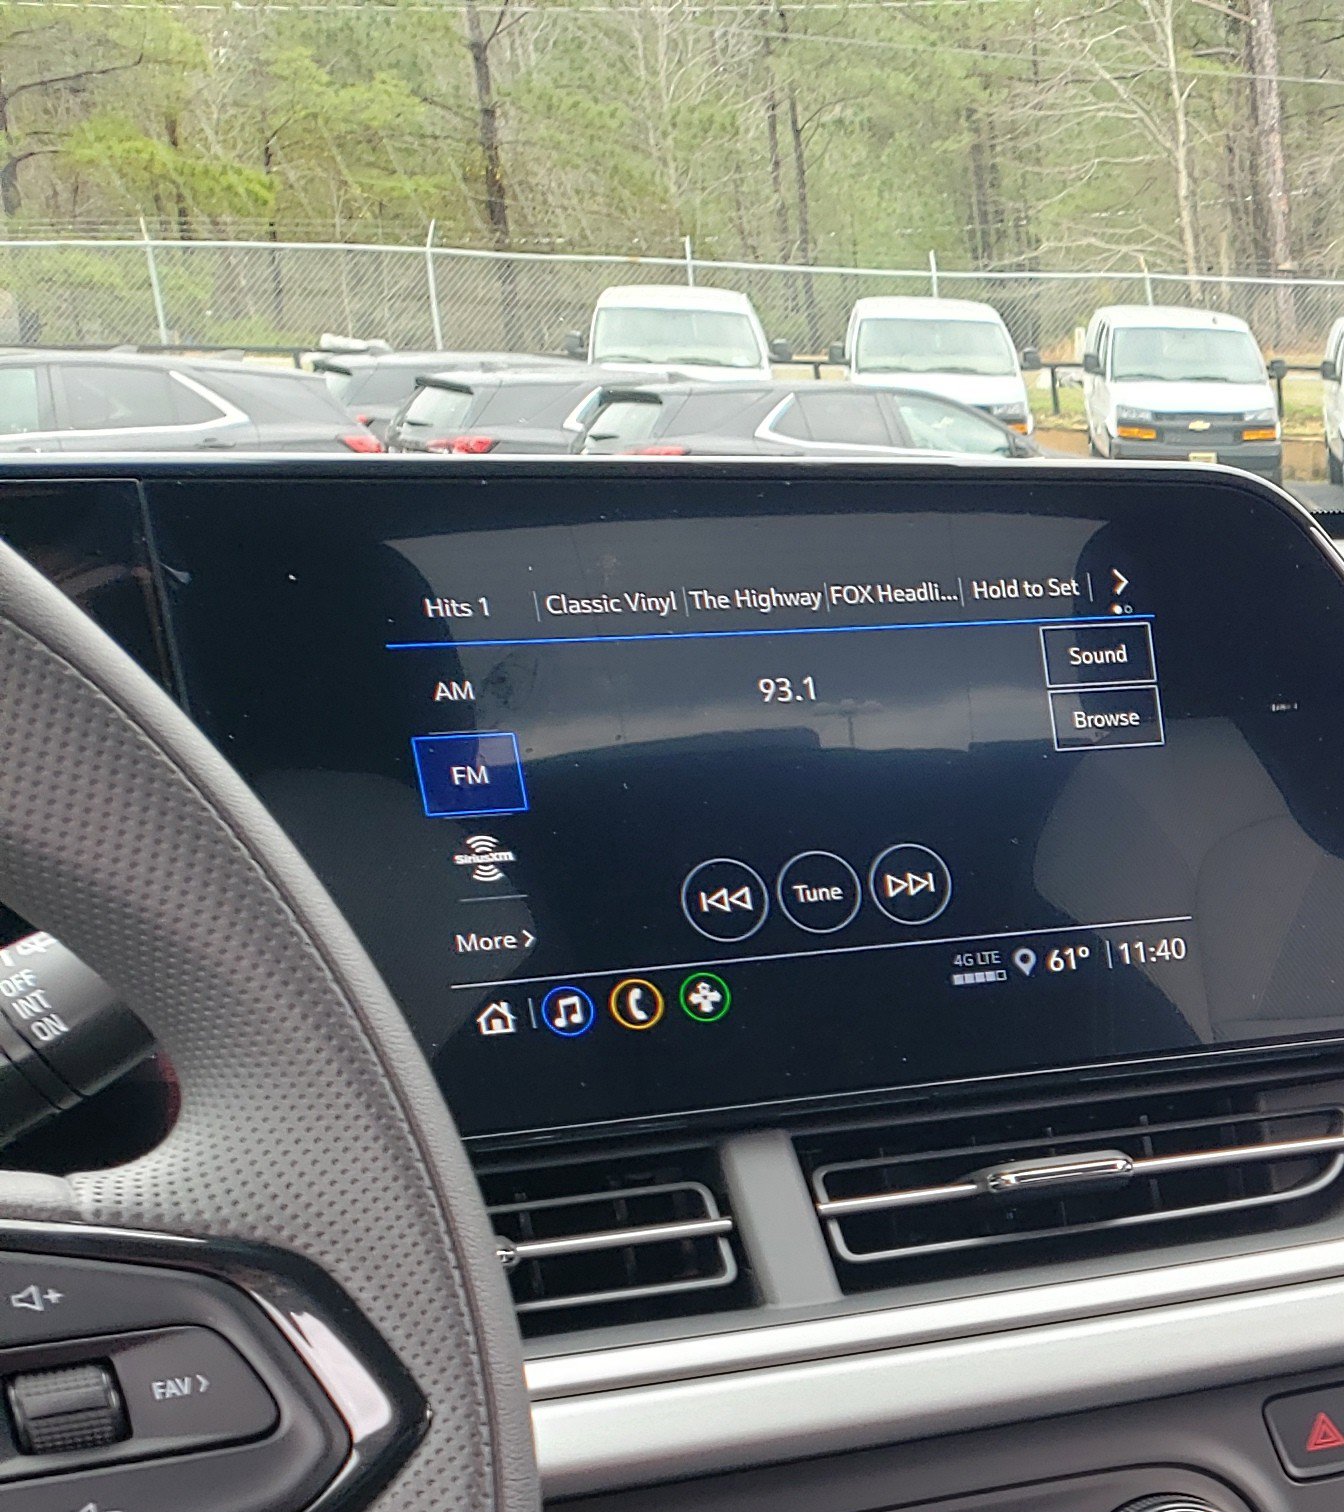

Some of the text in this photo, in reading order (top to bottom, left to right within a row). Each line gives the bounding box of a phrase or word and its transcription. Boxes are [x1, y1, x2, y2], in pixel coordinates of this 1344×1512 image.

[688, 586, 823, 614] The Highway
[829, 585, 874, 605] FOX
[972, 578, 1080, 600] Hold to Set
[424, 597, 490, 618] Hits 1
[545, 590, 678, 616] Classic Vinyl
[1070, 646, 1127, 665] Sound
[435, 680, 476, 701] AM
[758, 676, 818, 702] 93.1
[1074, 710, 1140, 730] Browse
[452, 765, 490, 785] FM
[793, 884, 844, 904] Tune
[455, 931, 518, 953] More
[1119, 937, 1187, 965] 11:40
[953, 951, 1001, 967] 4G LTE
[0, 968, 37, 998] OFF
[11, 989, 52, 1020] INT
[31, 1013, 69, 1041] ON
[152, 1376, 192, 1400] FAV
